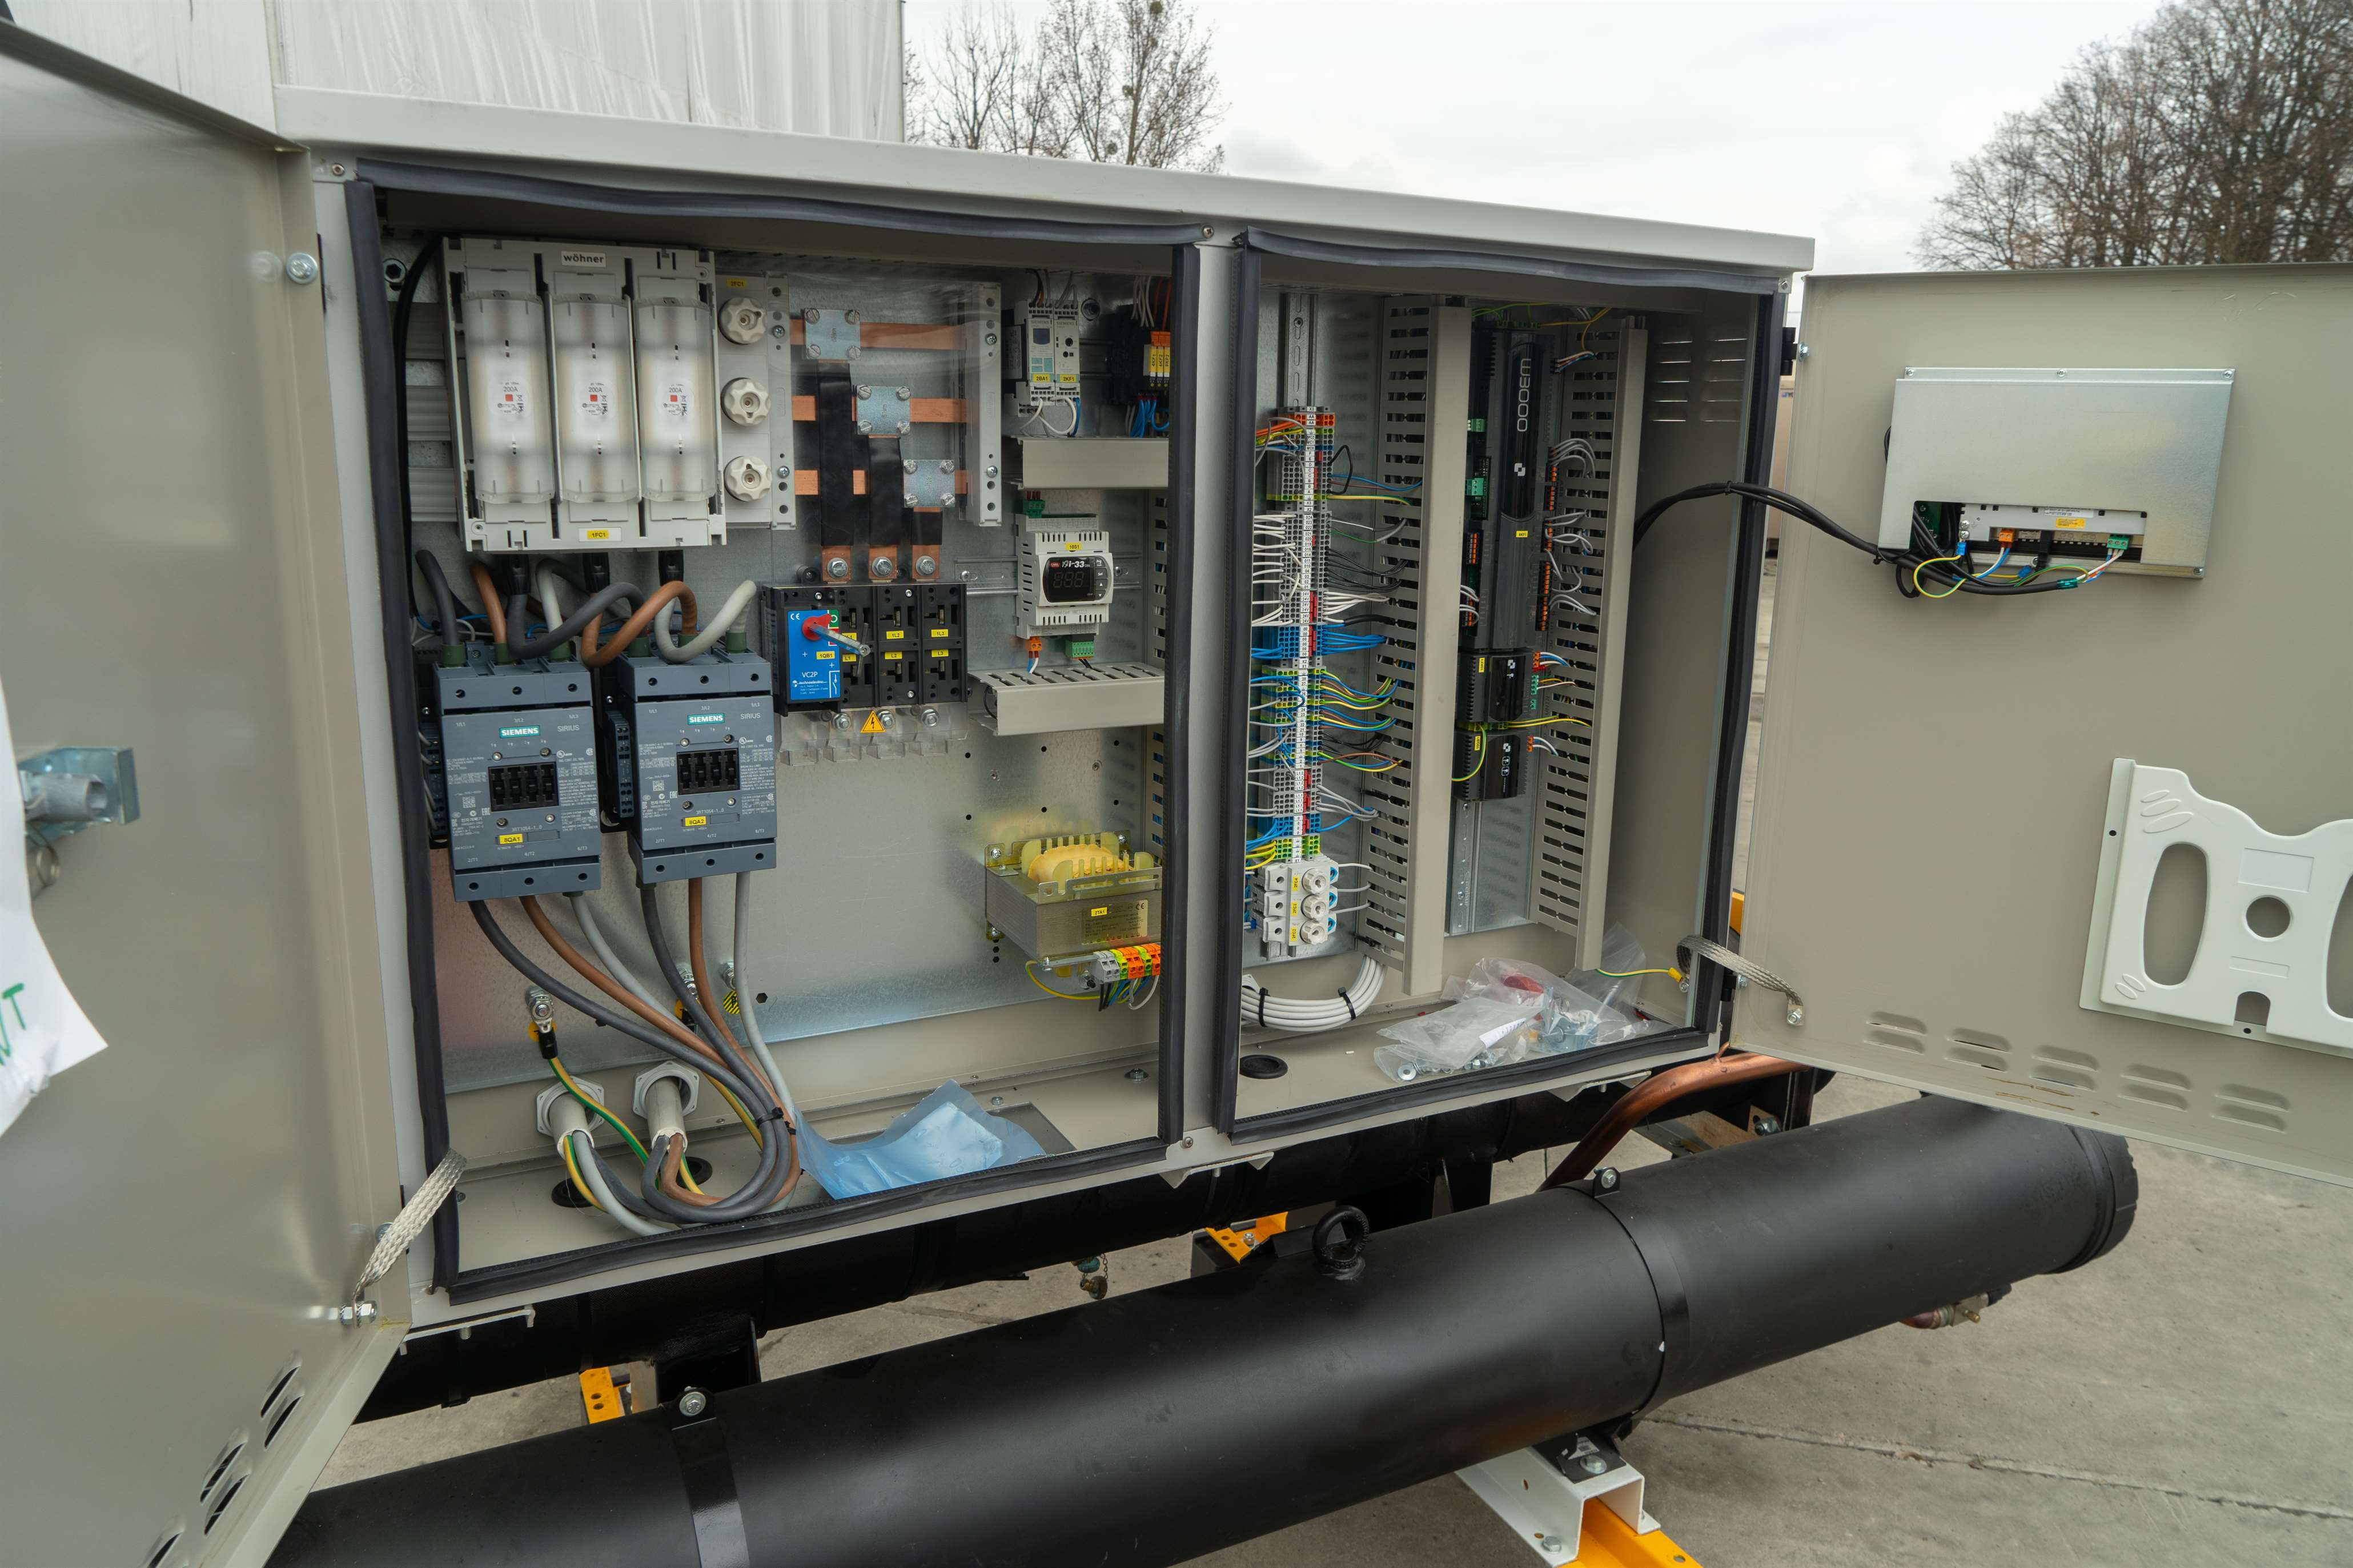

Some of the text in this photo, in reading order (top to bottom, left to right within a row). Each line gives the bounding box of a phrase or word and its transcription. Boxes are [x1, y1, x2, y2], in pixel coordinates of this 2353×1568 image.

[563, 254, 604, 263] wöhner
[1517, 359, 1531, 432] W3000
[501, 727, 539, 736] SIEMENS
